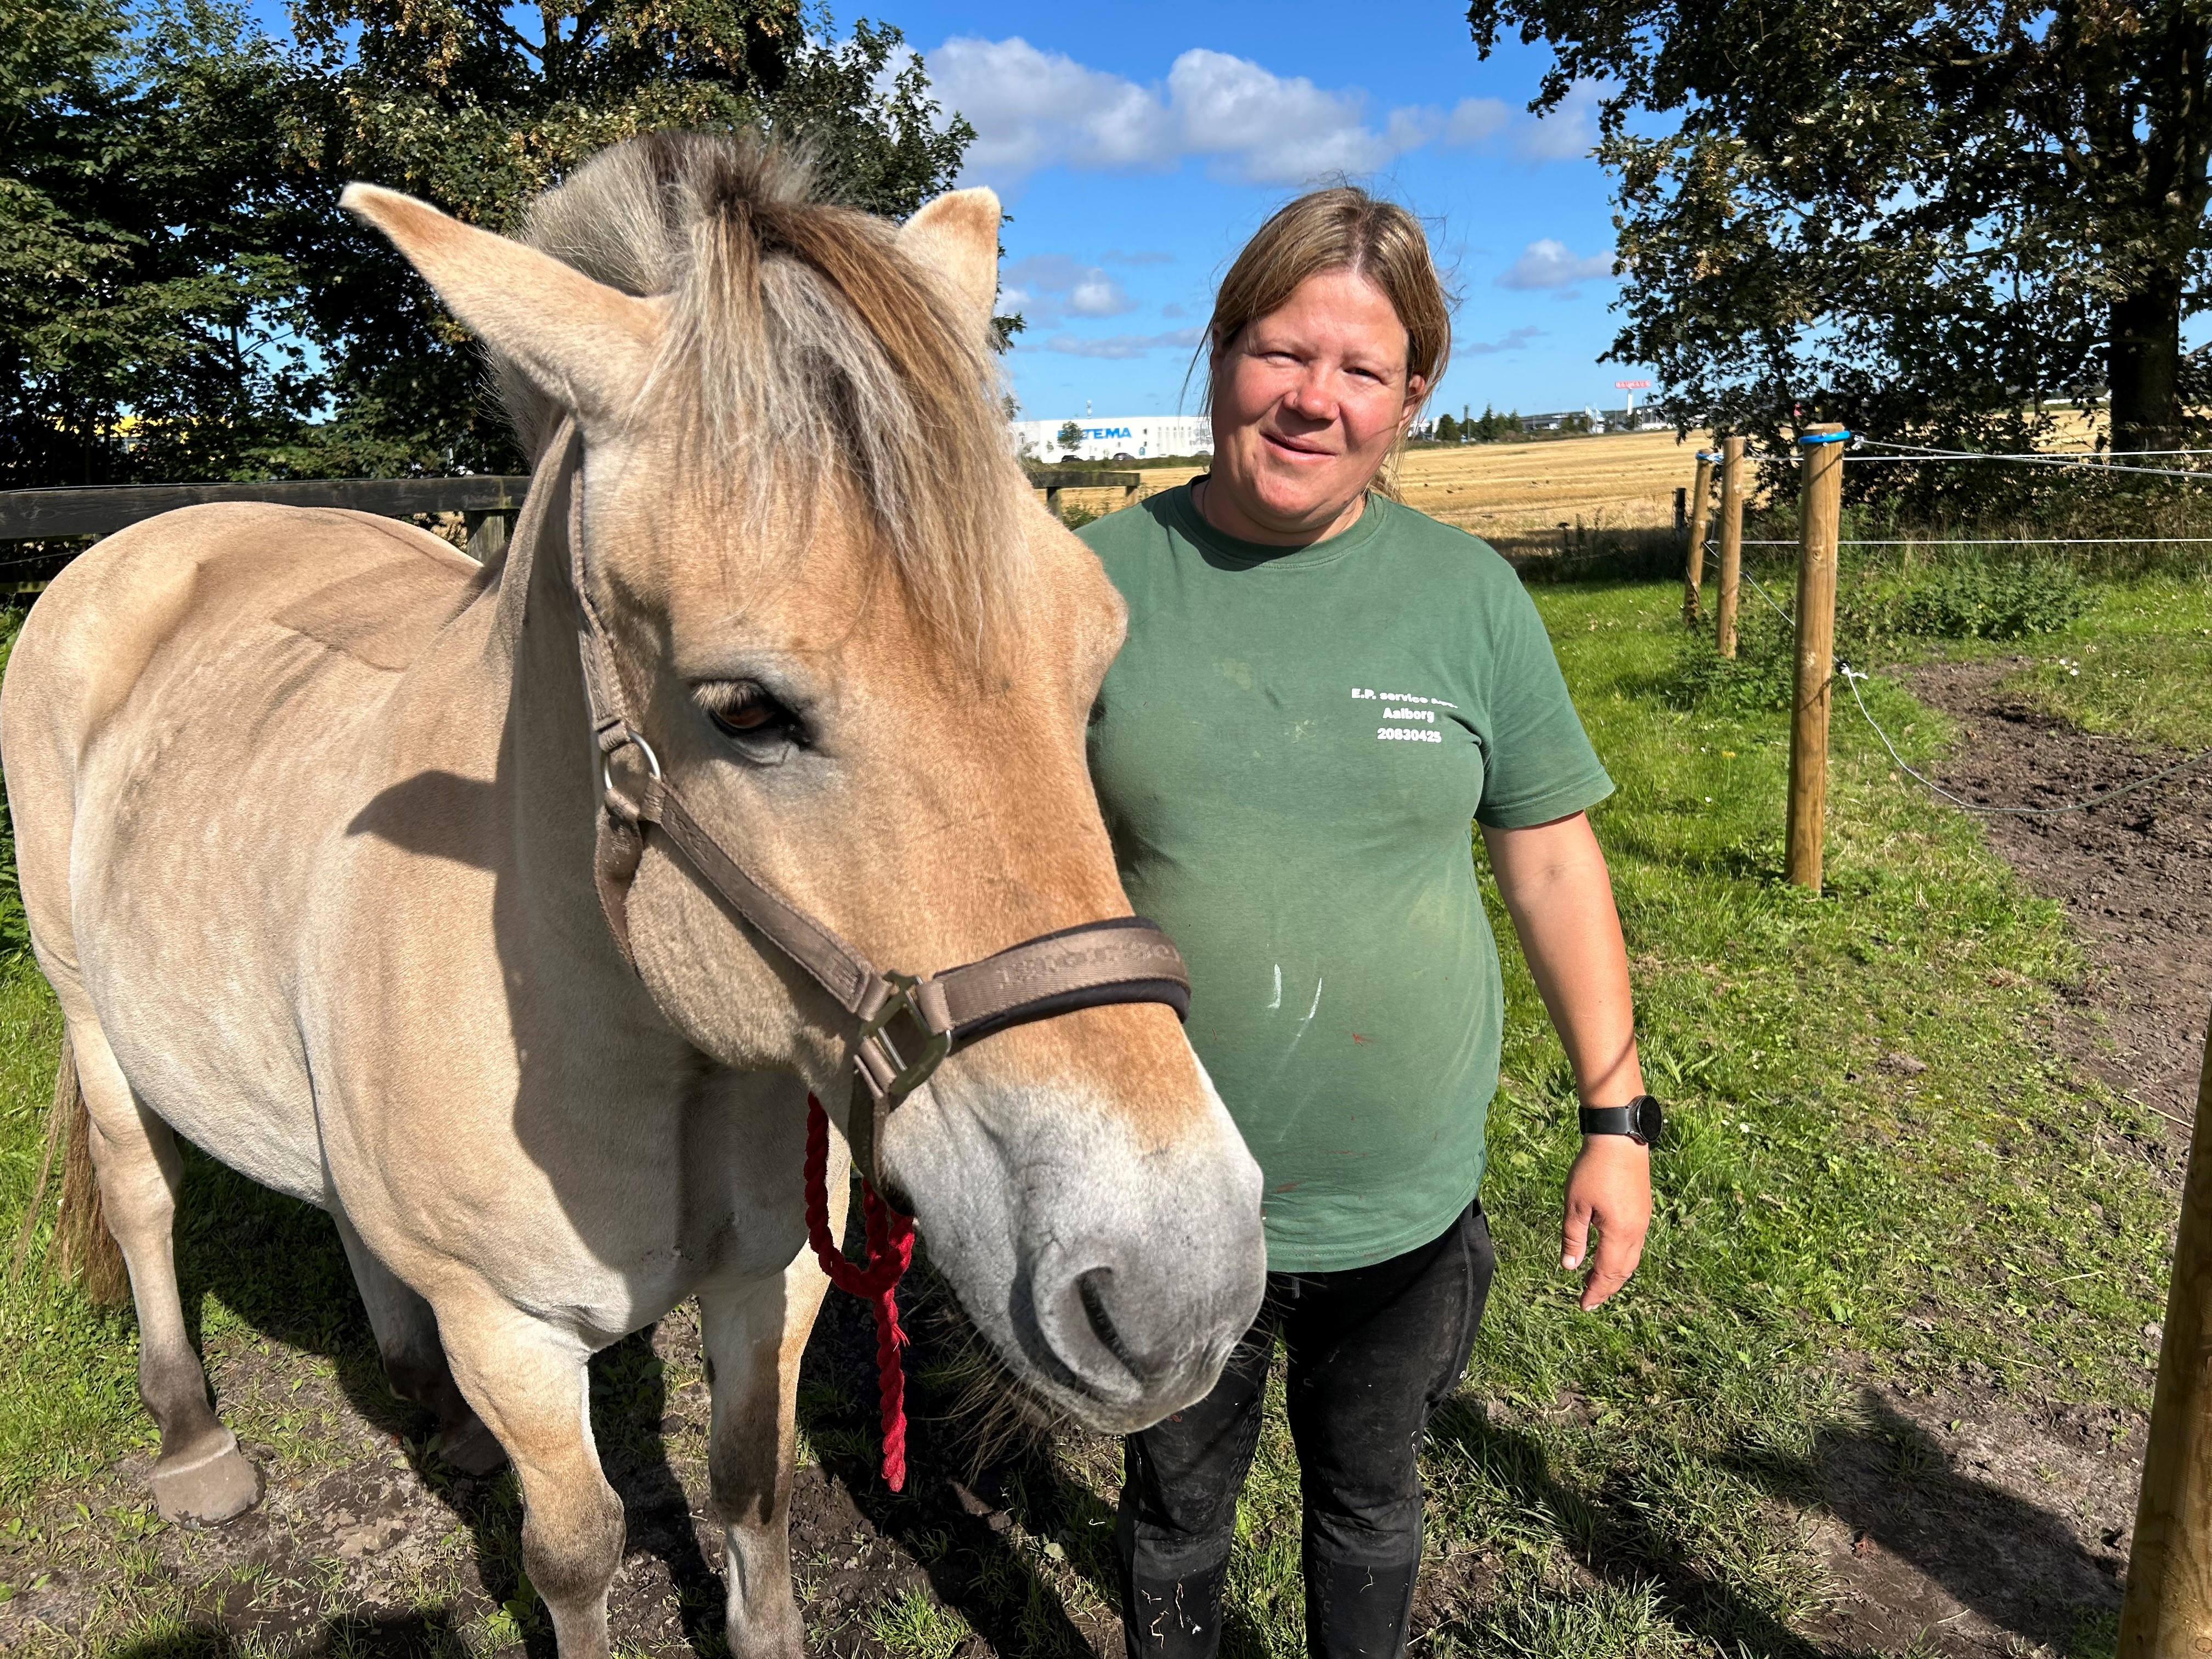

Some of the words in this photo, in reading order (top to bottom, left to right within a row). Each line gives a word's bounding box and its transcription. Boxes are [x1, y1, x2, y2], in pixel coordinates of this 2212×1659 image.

[1058, 427, 1132, 441] TEMA
[1351, 688, 1376, 699] E.P.
[1379, 692, 1428, 703] service
[1383, 707, 1435, 723] Aalborg
[1377, 727, 1442, 743] 20830425
